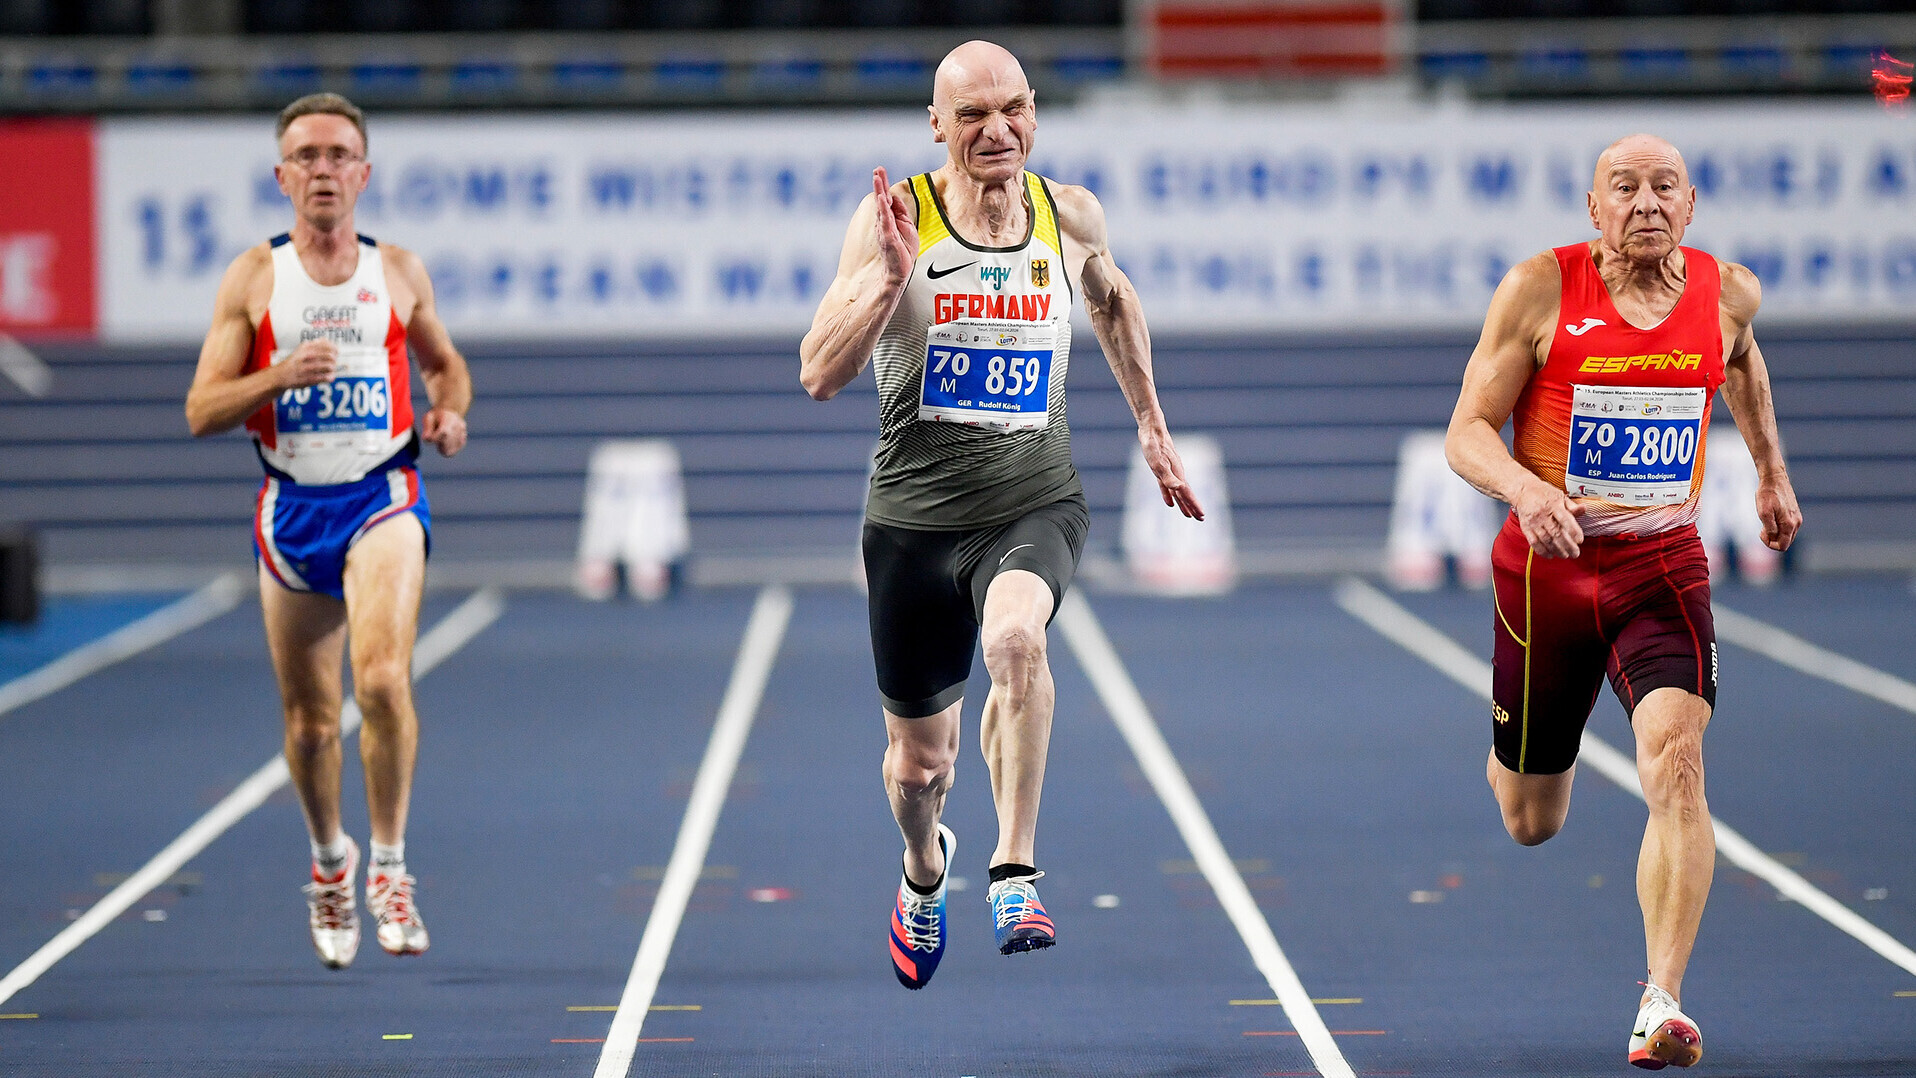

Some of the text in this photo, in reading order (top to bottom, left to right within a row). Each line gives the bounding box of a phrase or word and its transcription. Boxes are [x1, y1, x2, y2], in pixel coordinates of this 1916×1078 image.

[934, 293, 1051, 325] GERMANY
[1578, 349, 1702, 373] ESPAÑA
[933, 351, 1040, 396] 70 859
[940, 377, 956, 393] M
[316, 380, 387, 419] 3206
[957, 399, 1021, 412] GER Rudolf König
[1577, 421, 1695, 466] 70 2800
[1585, 449, 1602, 465] M
[1588, 469, 1602, 477] ESP
[1608, 471, 1625, 480] Juan
[1625, 472, 1646, 480] Carlos
